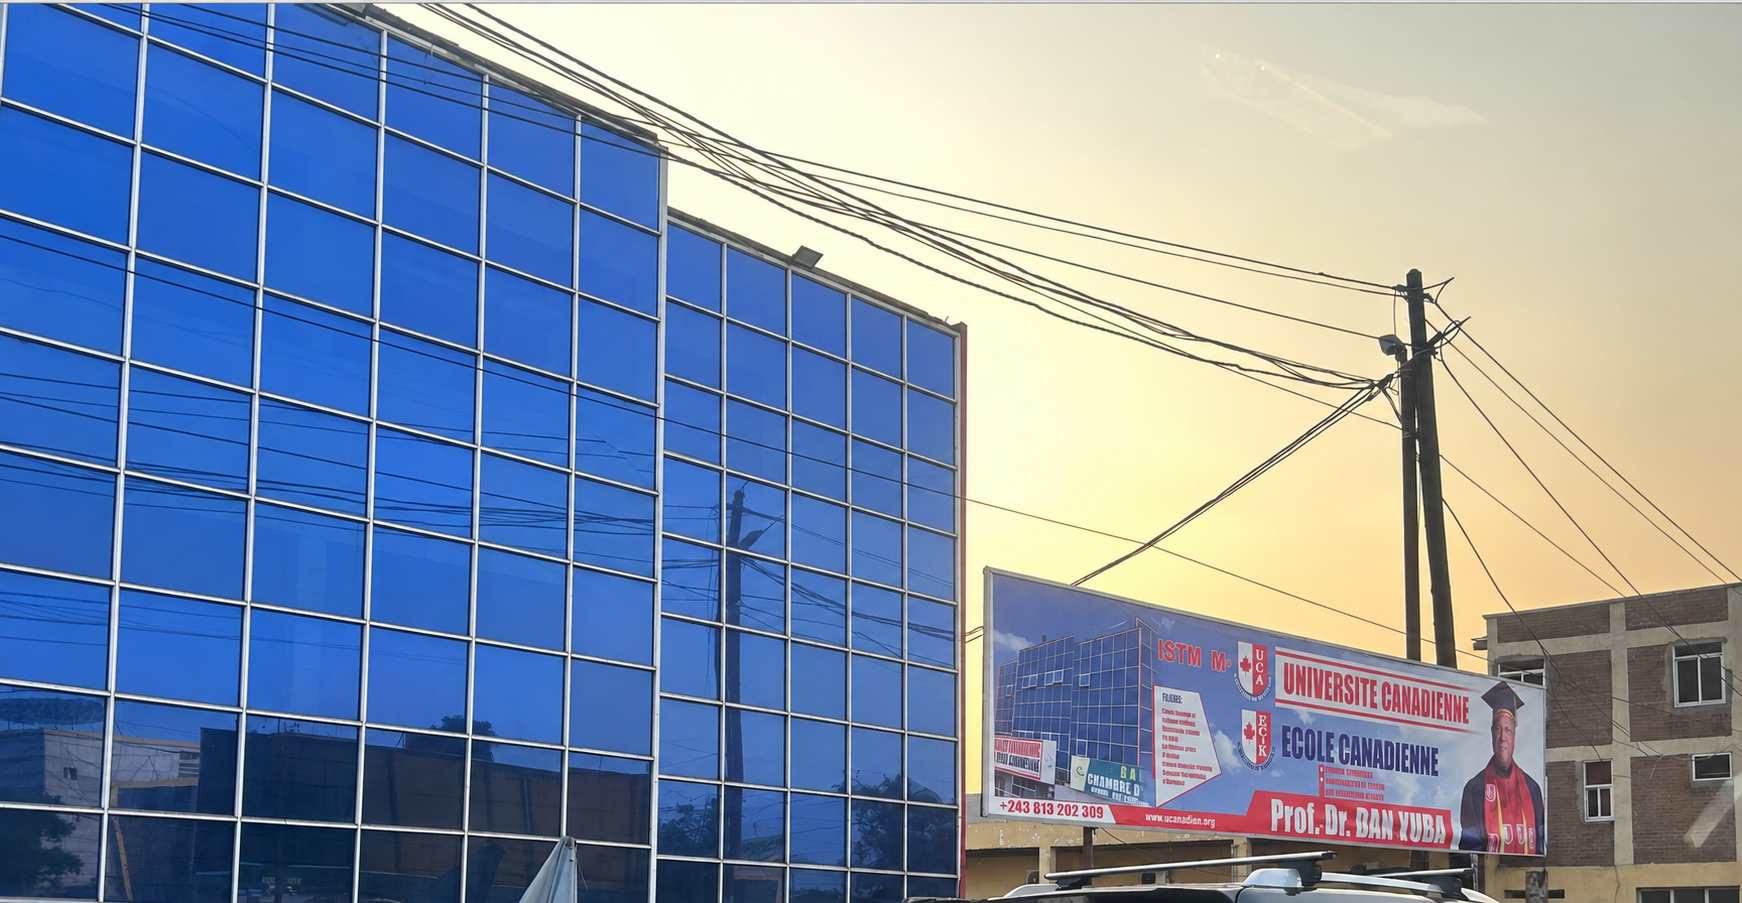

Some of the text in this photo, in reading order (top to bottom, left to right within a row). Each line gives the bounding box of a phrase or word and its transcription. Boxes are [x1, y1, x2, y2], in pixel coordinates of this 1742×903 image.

[1158, 638, 1202, 668] ISTM
[1255, 649, 1265, 686] UCA
[1283, 662, 1378, 709] UNIVERSITE
[1381, 681, 1470, 725] CANADIENNE
[1281, 724, 1335, 764] ECOLE
[1338, 733, 1439, 777] CANADIENNE
[1087, 773, 1132, 795] CHAMBRE
[1000, 799, 1104, 819] +243 813 202 309
[1325, 804, 1351, 837] Dr.
[1356, 807, 1394, 840] DAN
